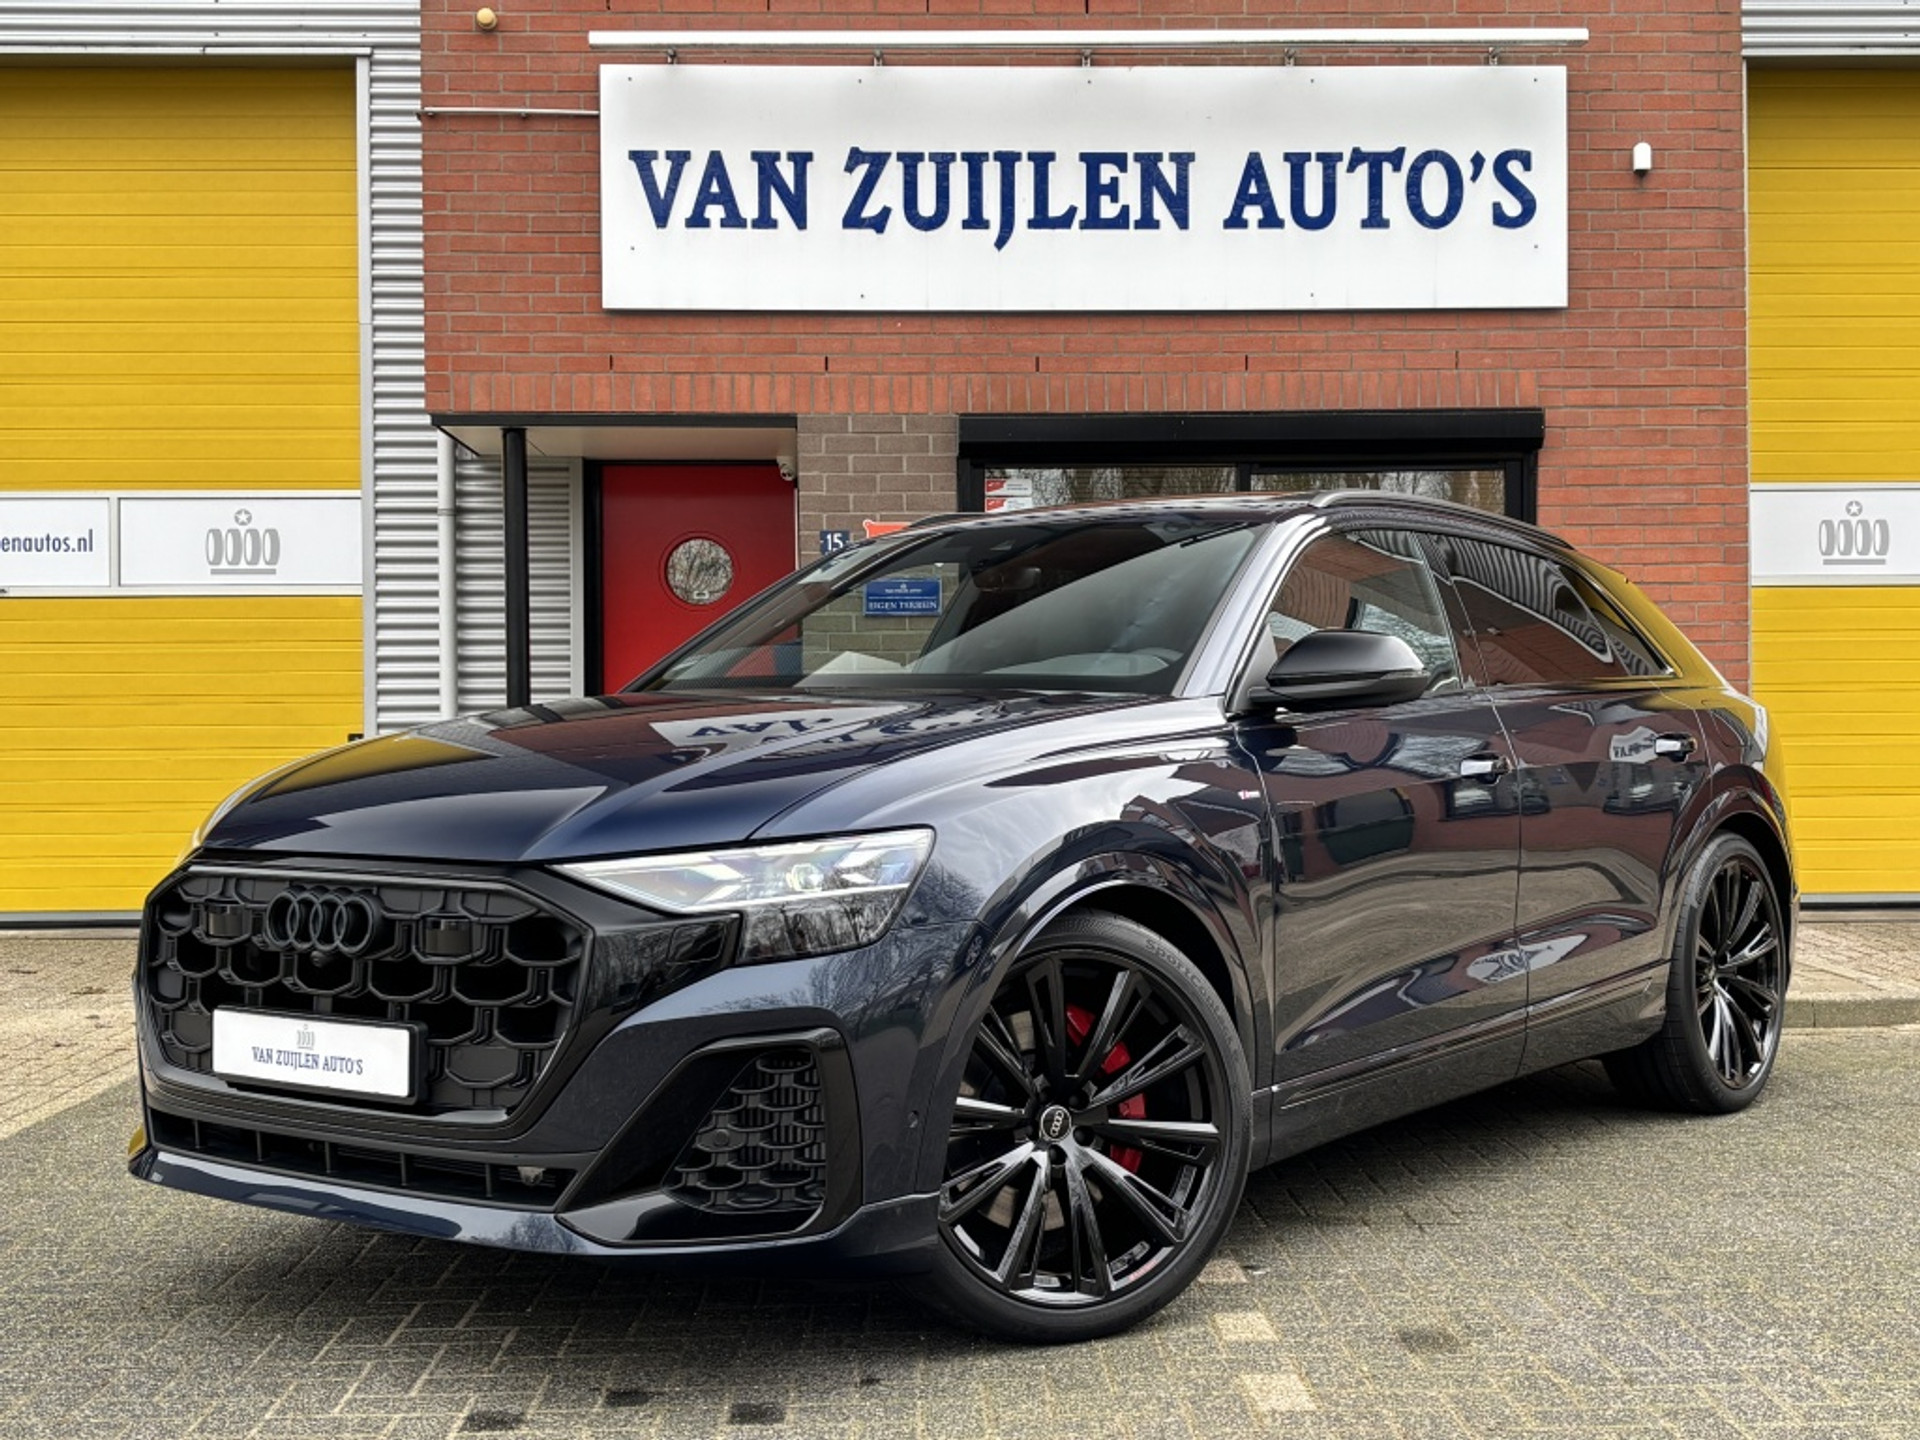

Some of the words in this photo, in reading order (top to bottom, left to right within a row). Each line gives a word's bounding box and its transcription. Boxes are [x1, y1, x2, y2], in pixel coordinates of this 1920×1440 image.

[628, 151, 814, 231] VAN
[842, 147, 1194, 252] ZUIJLEN
[1224, 147, 1538, 231] AUTO'S
[0, 528, 94, 553] enautos.nl
[826, 533, 844, 552] 15
[252, 1046, 274, 1065] VAN
[275, 1050, 320, 1071] ZUIJLEN
[322, 1056, 364, 1075] AUTO'S
